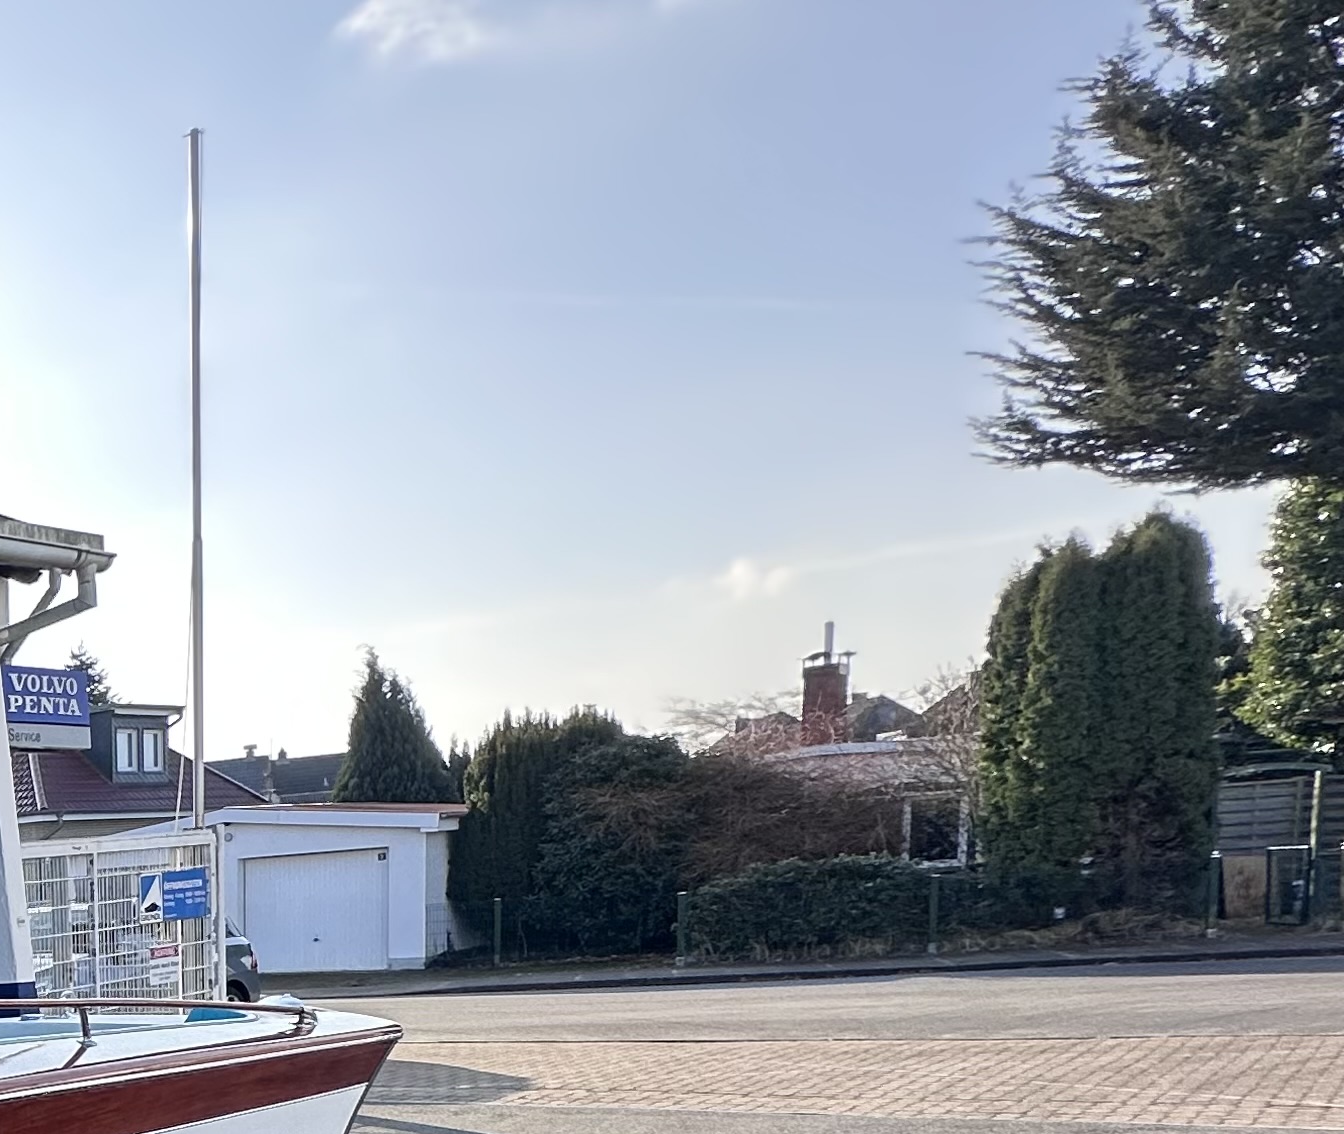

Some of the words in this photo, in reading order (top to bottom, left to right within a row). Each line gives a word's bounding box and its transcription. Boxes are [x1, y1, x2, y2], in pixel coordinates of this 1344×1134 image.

[7, 673, 79, 696] VOLVO
[7, 694, 83, 717] PENTA
[8, 727, 42, 743] Service
